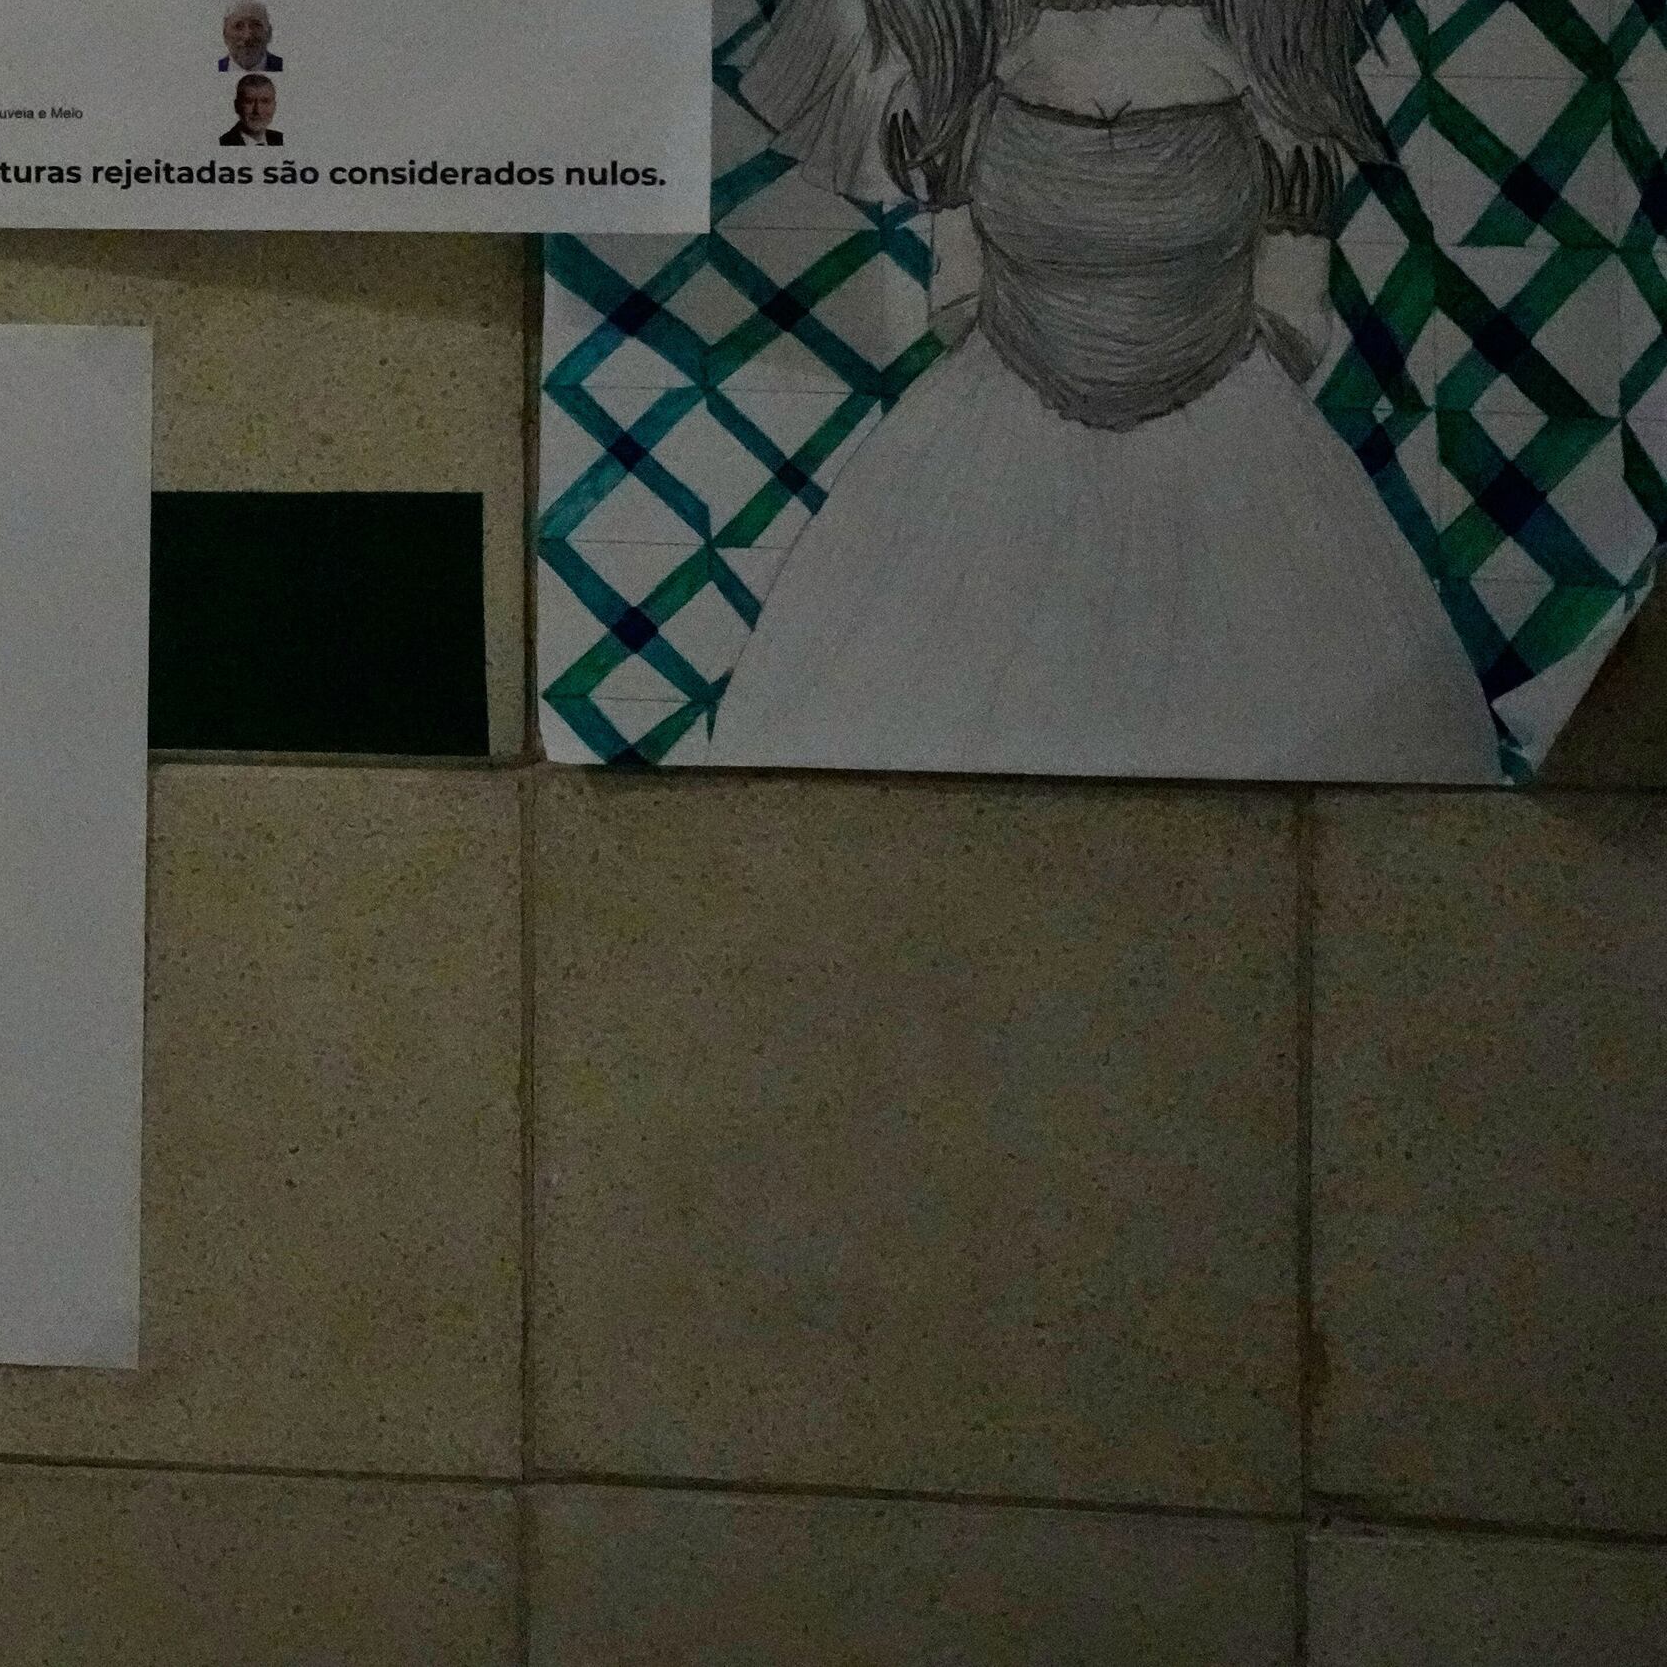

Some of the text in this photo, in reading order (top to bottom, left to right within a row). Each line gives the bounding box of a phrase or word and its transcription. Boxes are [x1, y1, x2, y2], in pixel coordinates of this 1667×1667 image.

[91, 157, 254, 191] rejeitadas
[262, 159, 320, 186] são
[328, 157, 555, 187] considerados
[565, 159, 667, 188] nulos.
